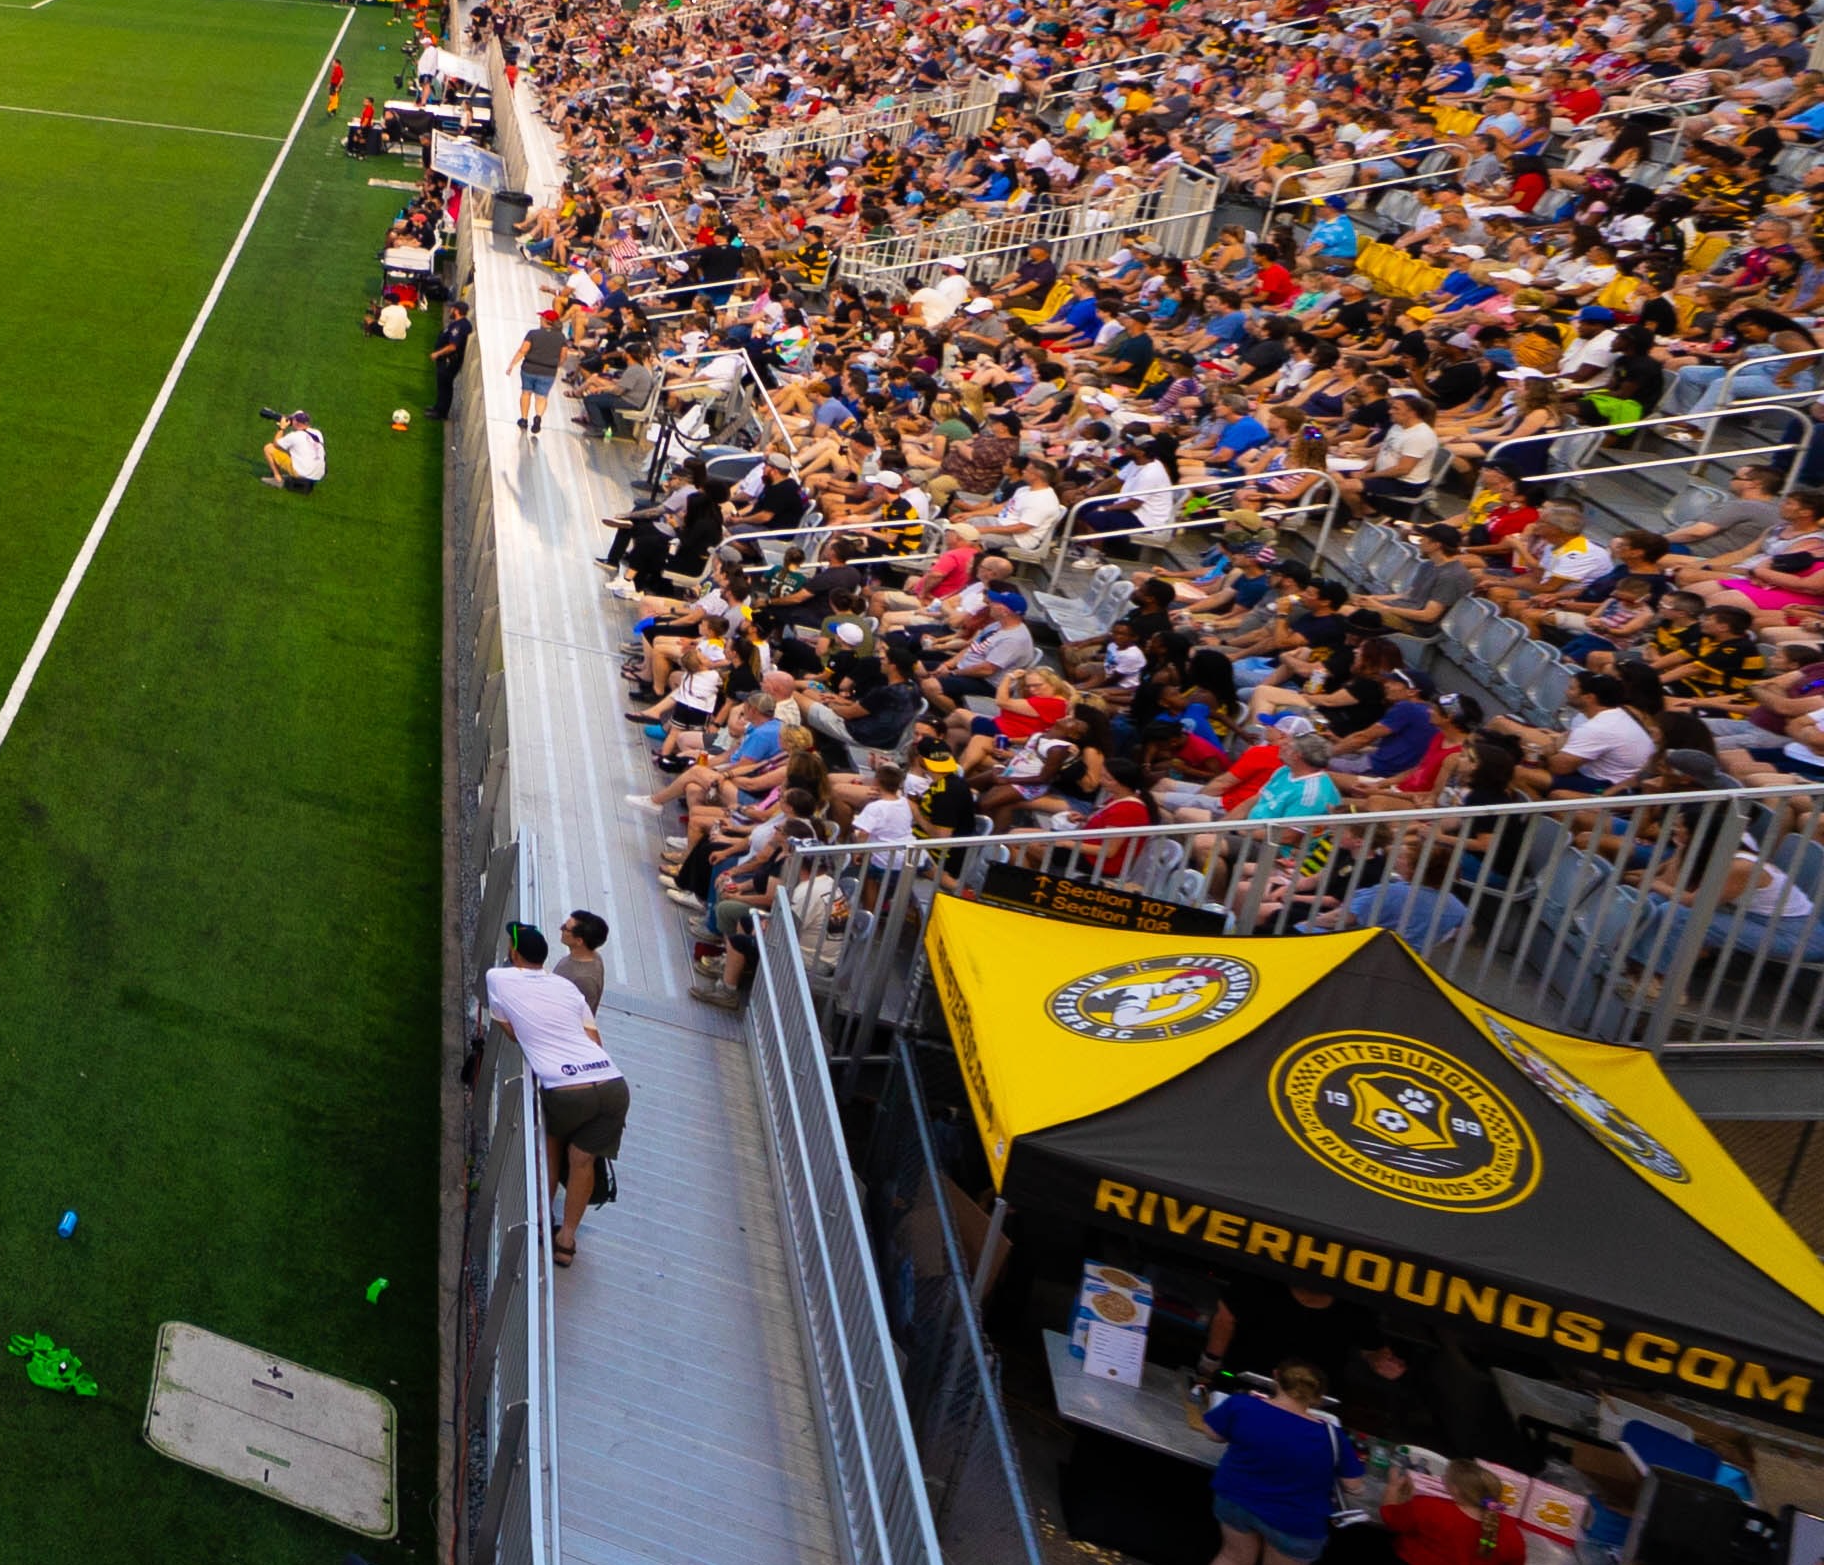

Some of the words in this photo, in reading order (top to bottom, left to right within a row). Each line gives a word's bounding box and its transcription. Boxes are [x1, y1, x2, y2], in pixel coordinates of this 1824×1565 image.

[1051, 895, 1127, 926] Section
[1056, 879, 1133, 910] Section
[1140, 900, 1177, 919] 107
[1054, 974, 1109, 1030] RIVETERS
[1095, 1027, 1135, 1040] SC
[1176, 956, 1251, 1021] PITTSBURGH
[576, 1059, 611, 1073] LUMBER
[1311, 1045, 1482, 1100] PITTSBURGH
[1324, 1089, 1350, 1107] 19
[1452, 1117, 1484, 1137] 99
[1317, 1134, 1473, 1197] RIVERHOUNDS
[1473, 1172, 1500, 1192] SC
[1092, 1178, 1812, 1414] RIVERHOUNDS.COM
